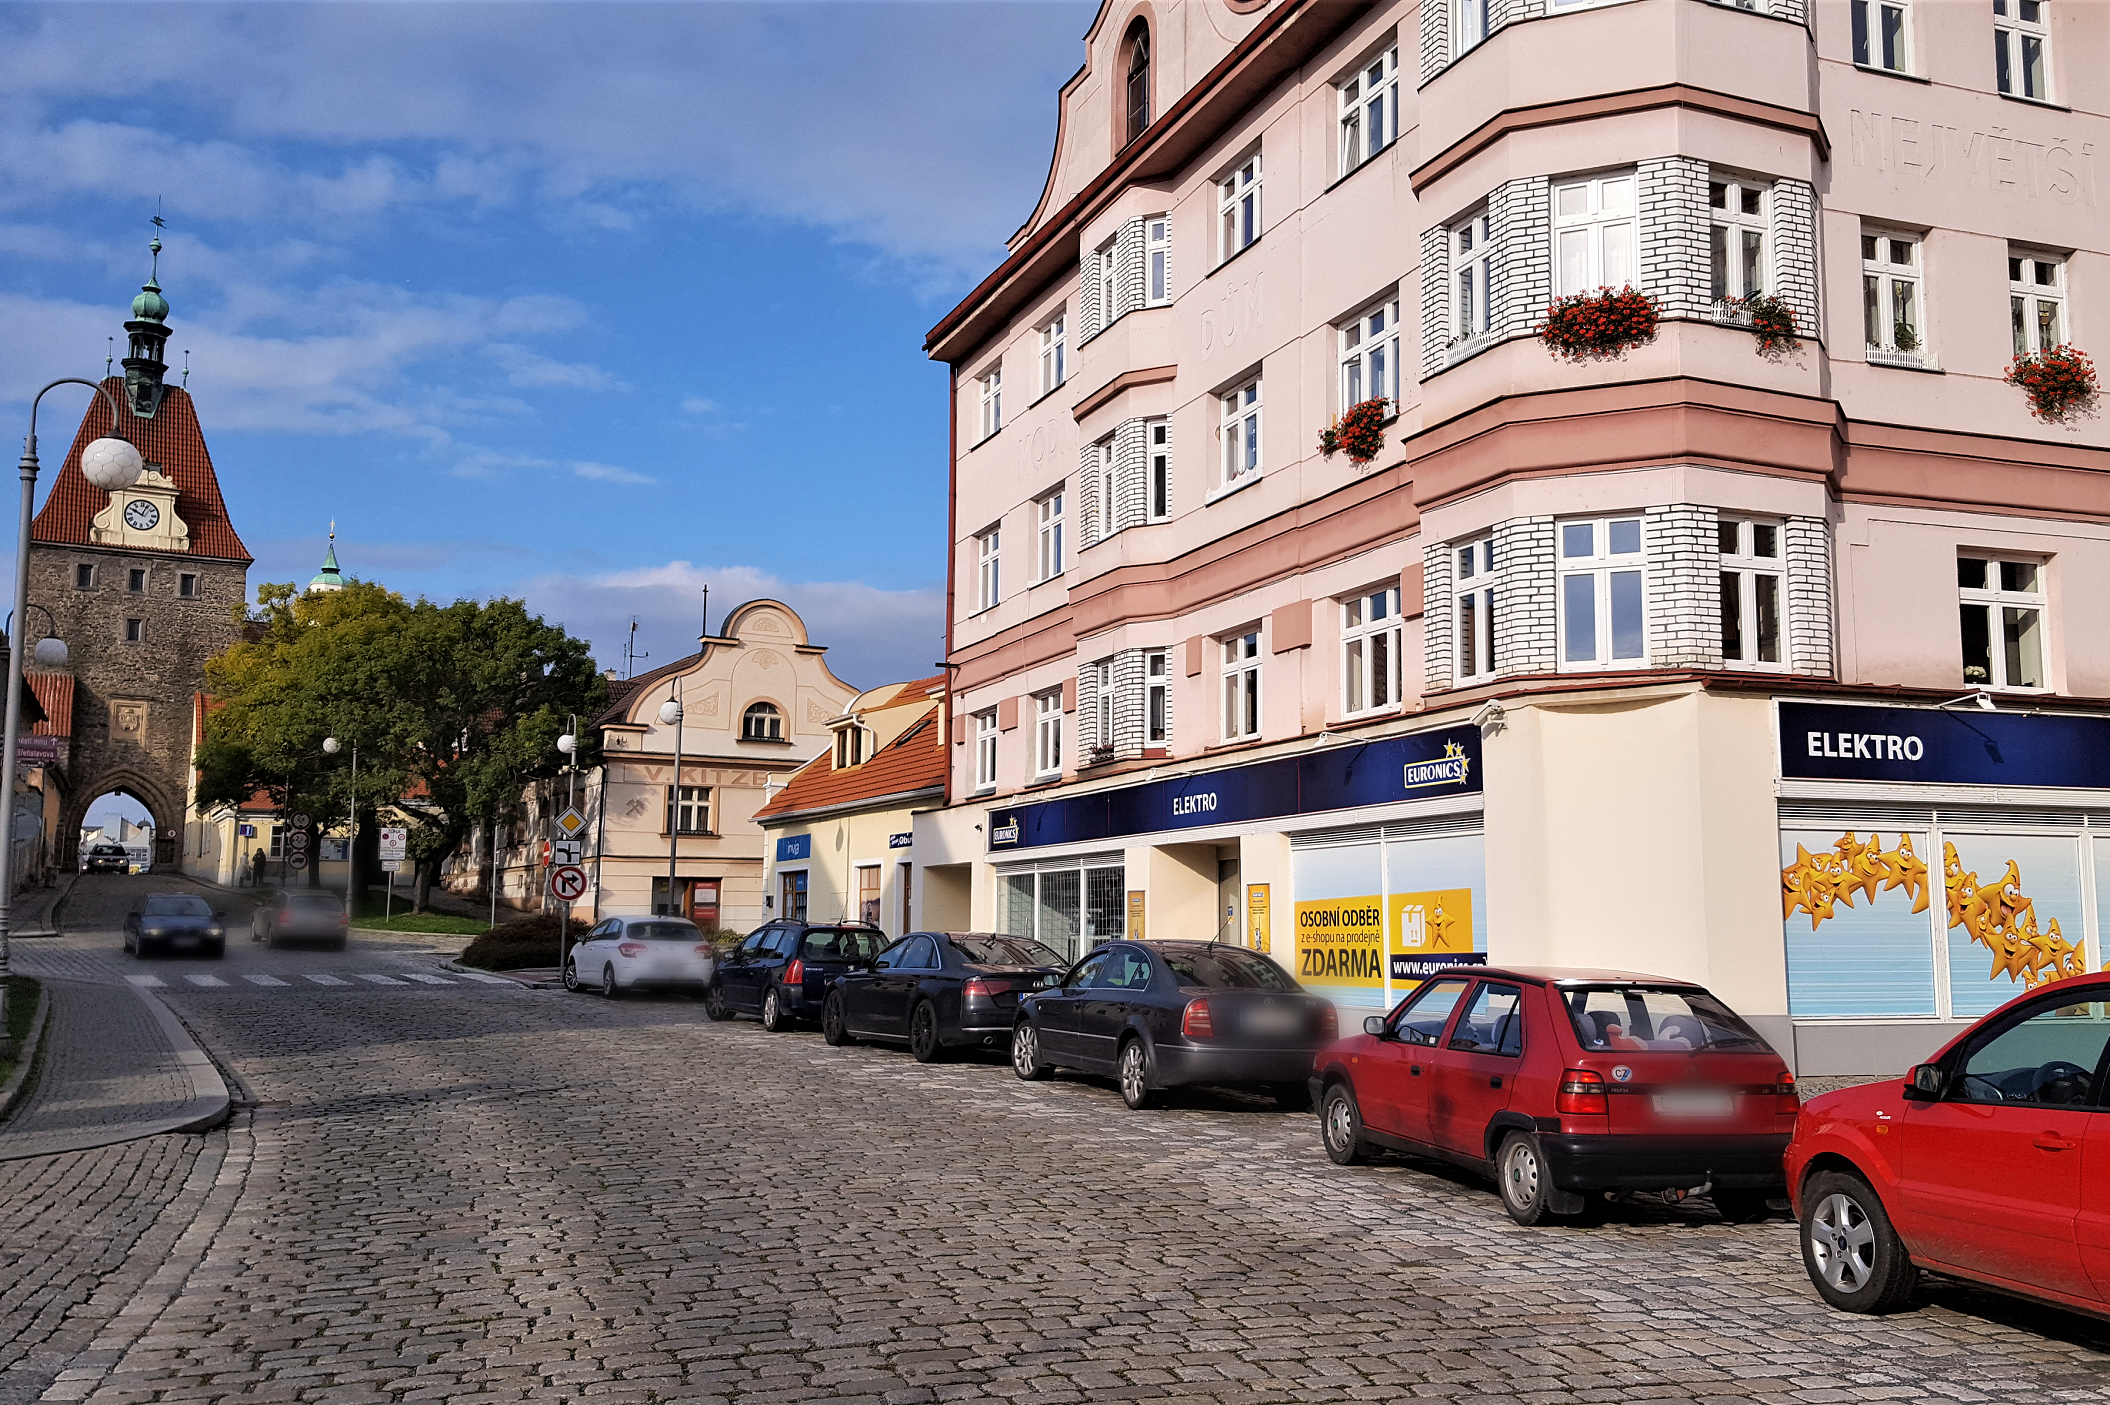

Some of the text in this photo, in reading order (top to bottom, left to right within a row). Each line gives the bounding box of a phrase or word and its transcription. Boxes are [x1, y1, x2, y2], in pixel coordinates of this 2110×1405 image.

[1850, 108, 2097, 208] NEJVĚTŠÍ
[1201, 270, 1264, 363] DŮM
[1807, 731, 1924, 761] ELEKTRO
[1407, 761, 1460, 783] EURONICS
[1173, 792, 1217, 816] ELEKTRO
[1300, 905, 1380, 927] OSOBNÍ ODBĚR
[1301, 929, 1380, 946] z e-shopu na prodejně
[1301, 948, 1382, 978] ZDARMA
[1614, 1069, 1628, 1078] CZ
